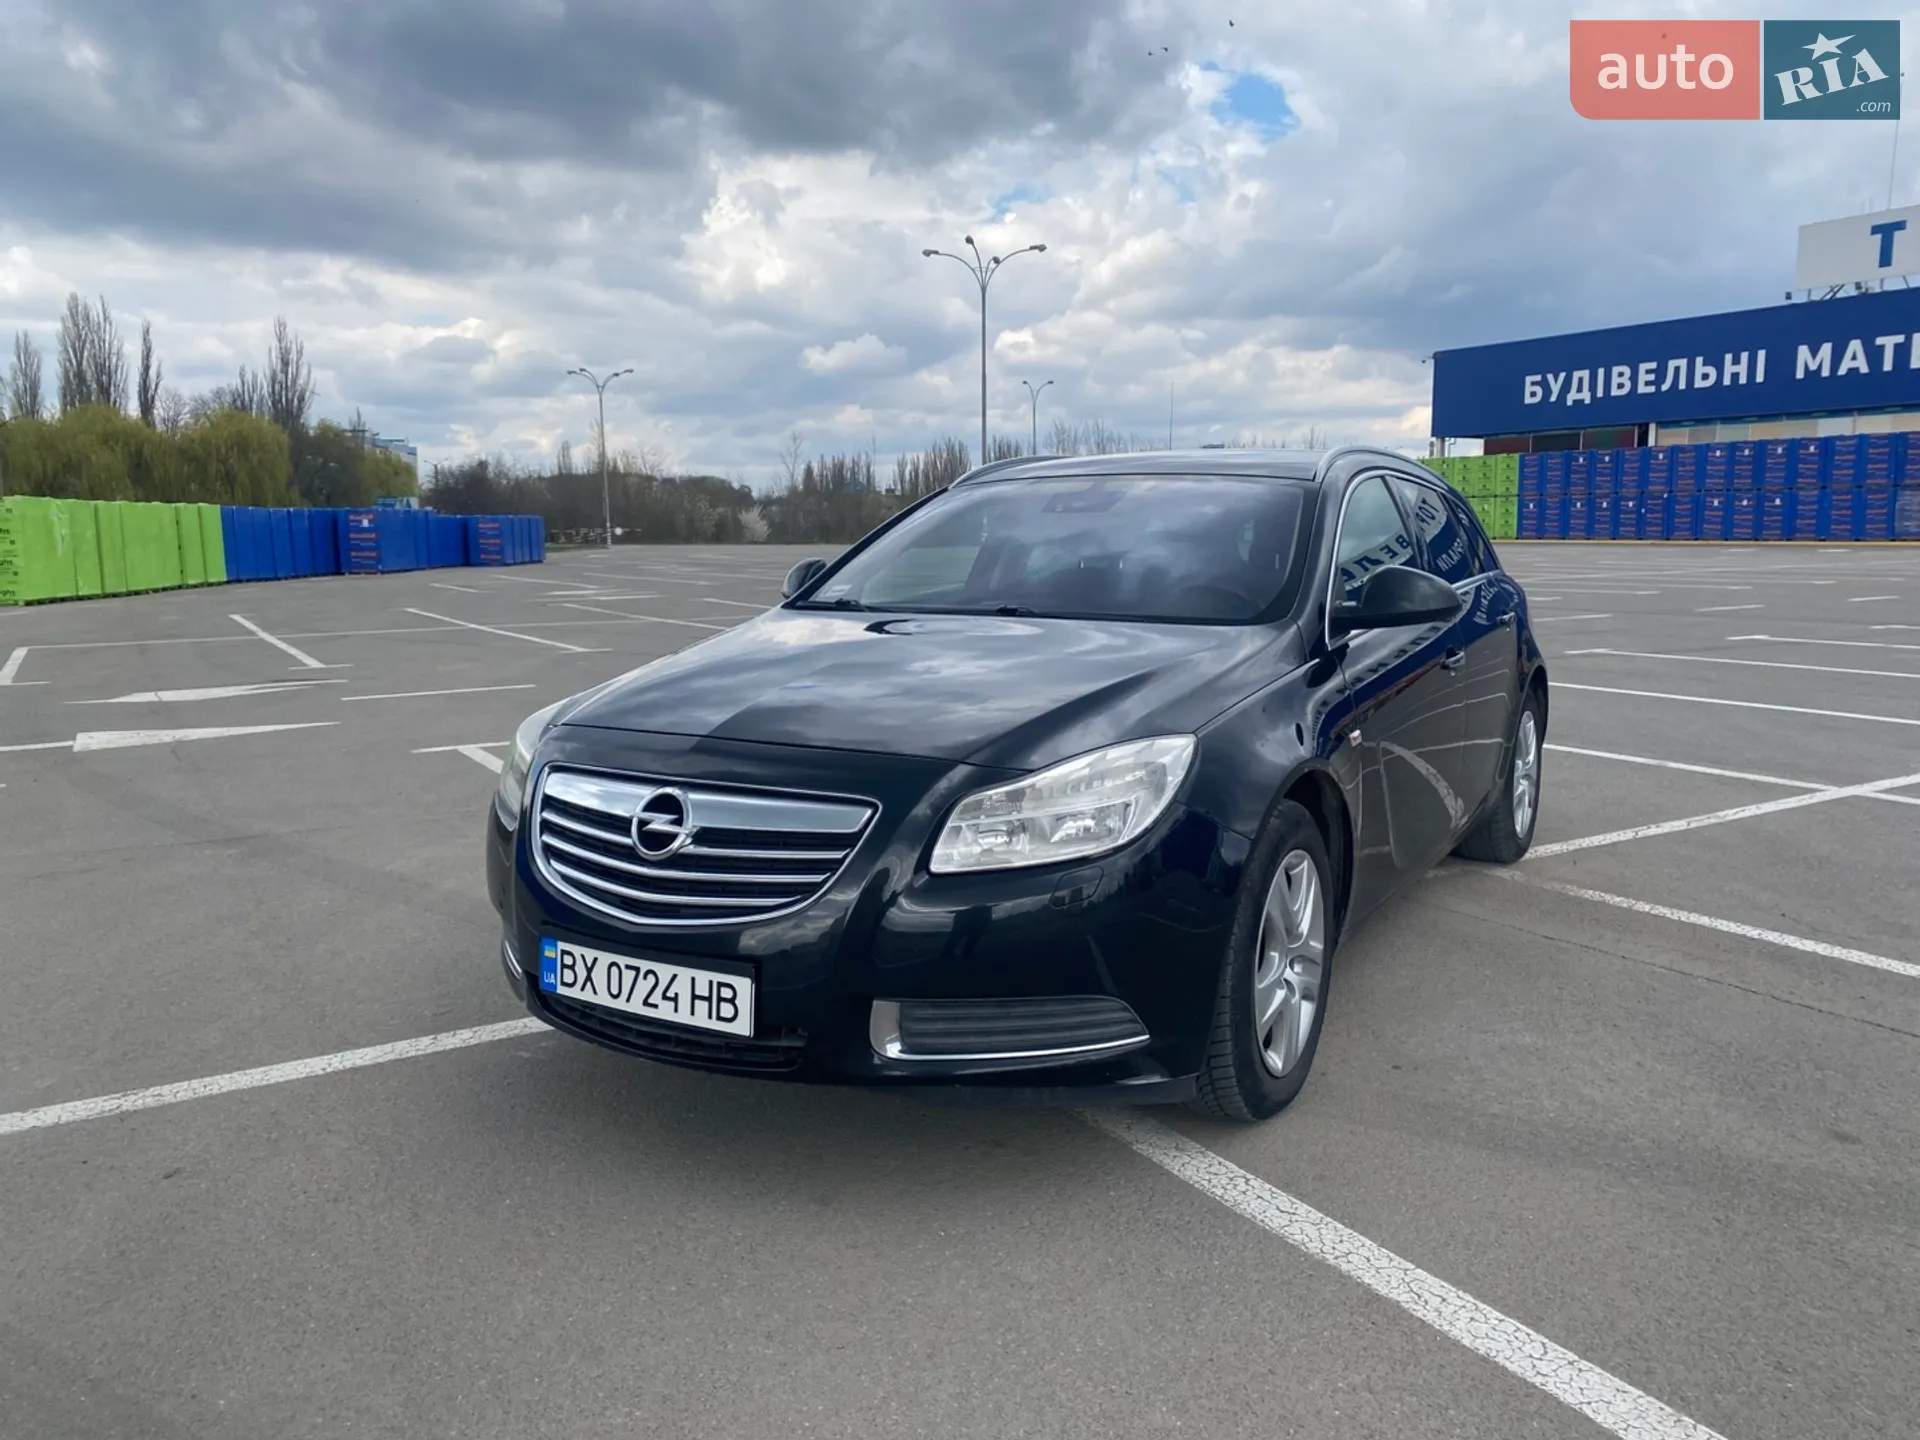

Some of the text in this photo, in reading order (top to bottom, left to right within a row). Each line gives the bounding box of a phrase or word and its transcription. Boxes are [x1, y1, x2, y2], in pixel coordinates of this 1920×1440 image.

[1523, 349, 1767, 406] БУДІВЕЛЬНІ
[543, 971, 556, 985] UA
[560, 948, 739, 1024] BX 0724 HB
